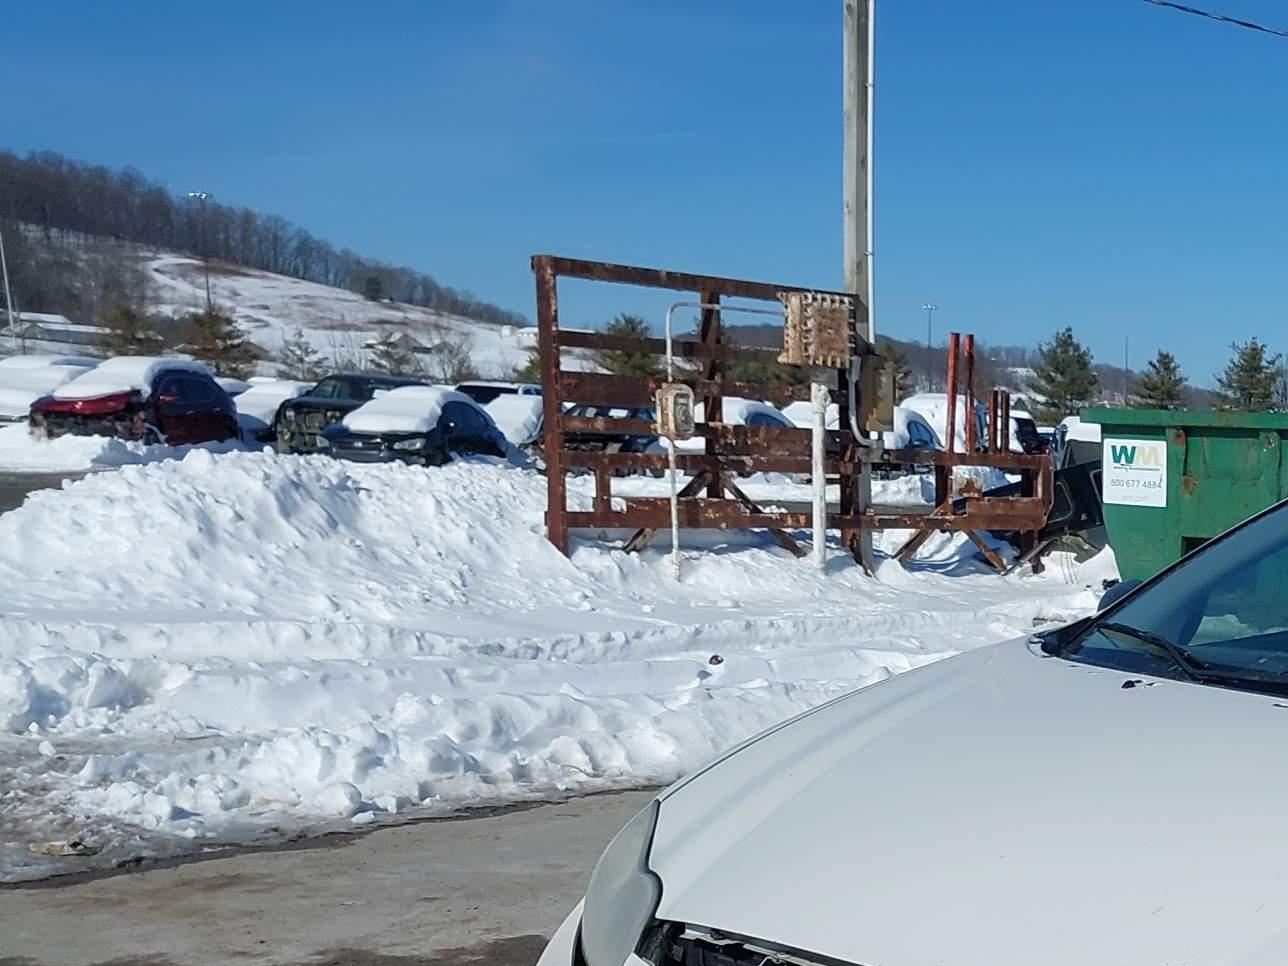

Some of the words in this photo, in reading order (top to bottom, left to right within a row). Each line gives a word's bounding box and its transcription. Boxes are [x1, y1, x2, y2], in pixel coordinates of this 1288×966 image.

[1111, 444, 1161, 466] WM
[1110, 478, 1125, 487] 800
[1126, 479, 1140, 489] 677
